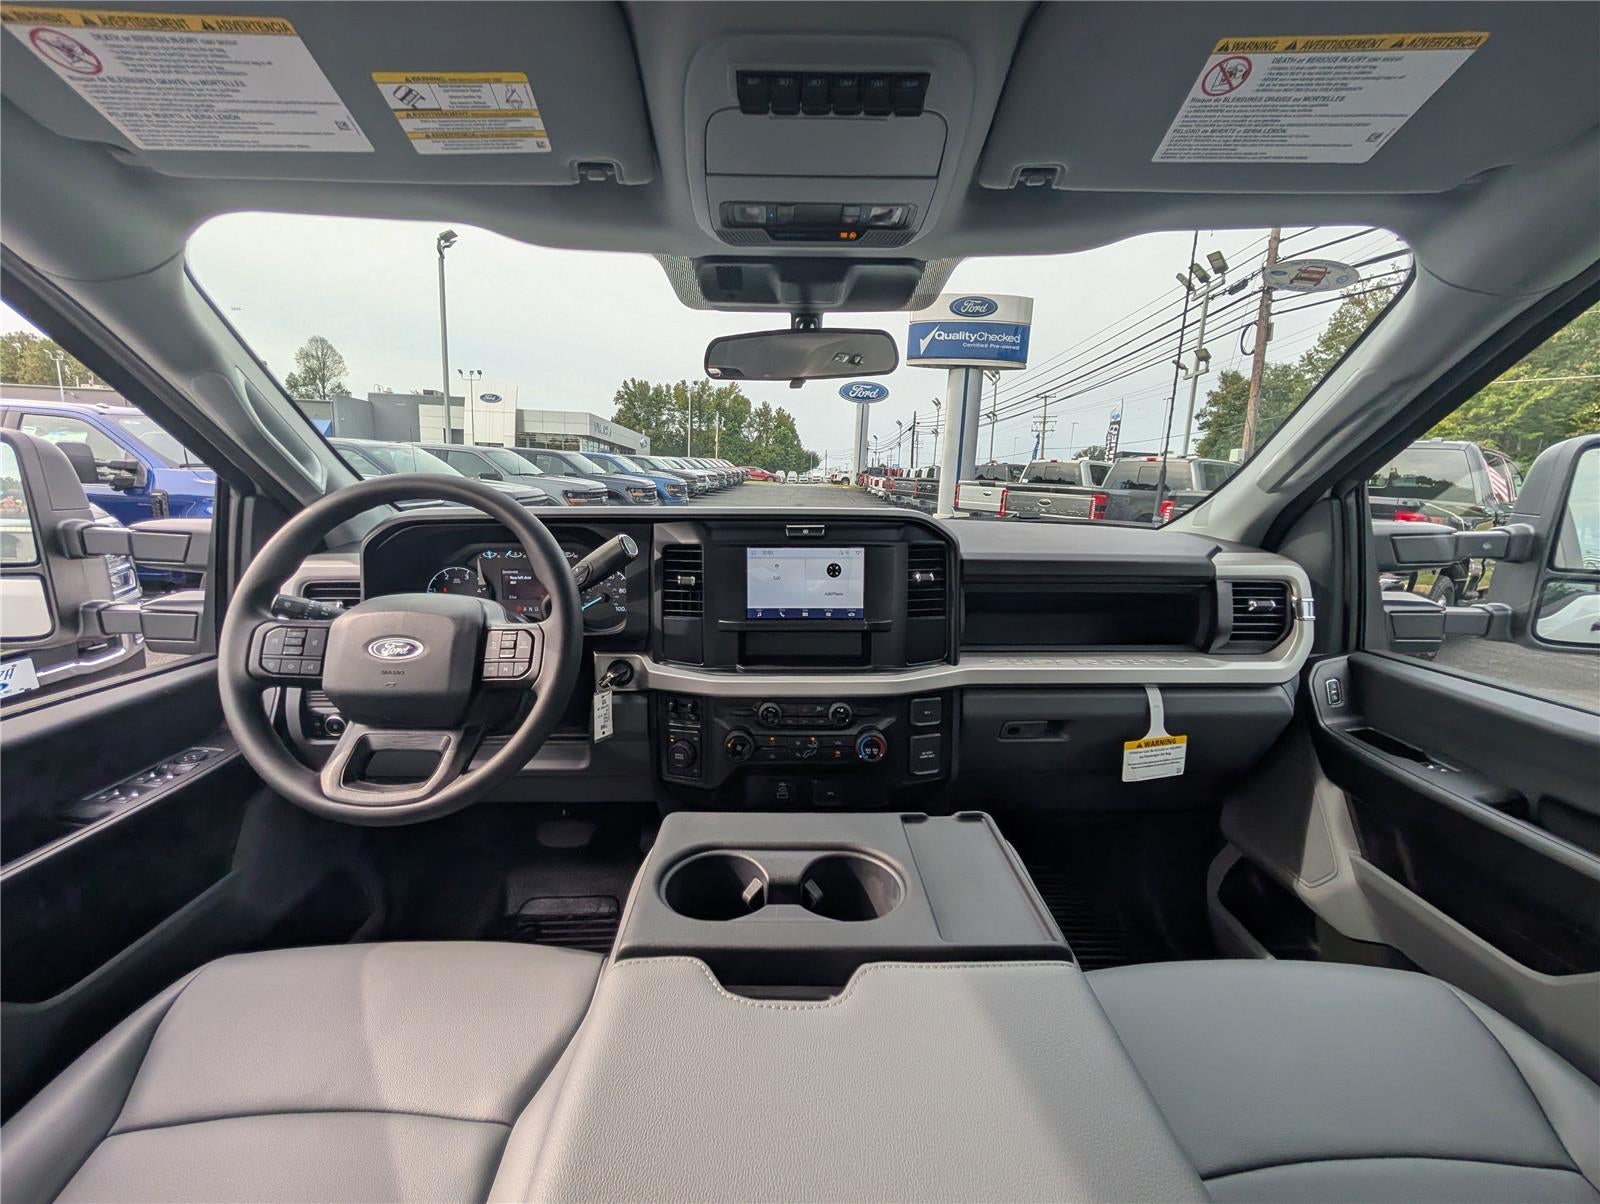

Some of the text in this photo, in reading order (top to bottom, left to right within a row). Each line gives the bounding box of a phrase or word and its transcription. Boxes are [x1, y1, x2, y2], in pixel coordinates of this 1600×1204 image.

[216, 20, 293, 33] ADVERTENCIA
[1230, 36, 1482, 52] WARNING AVERTISSEMENT ADVERTENCIA
[960, 300, 988, 313] Ford
[934, 331, 1021, 343] QualityChecked
[849, 384, 880, 398] Ford
[381, 641, 410, 656] Ford
[1144, 738, 1176, 747] WARNING
